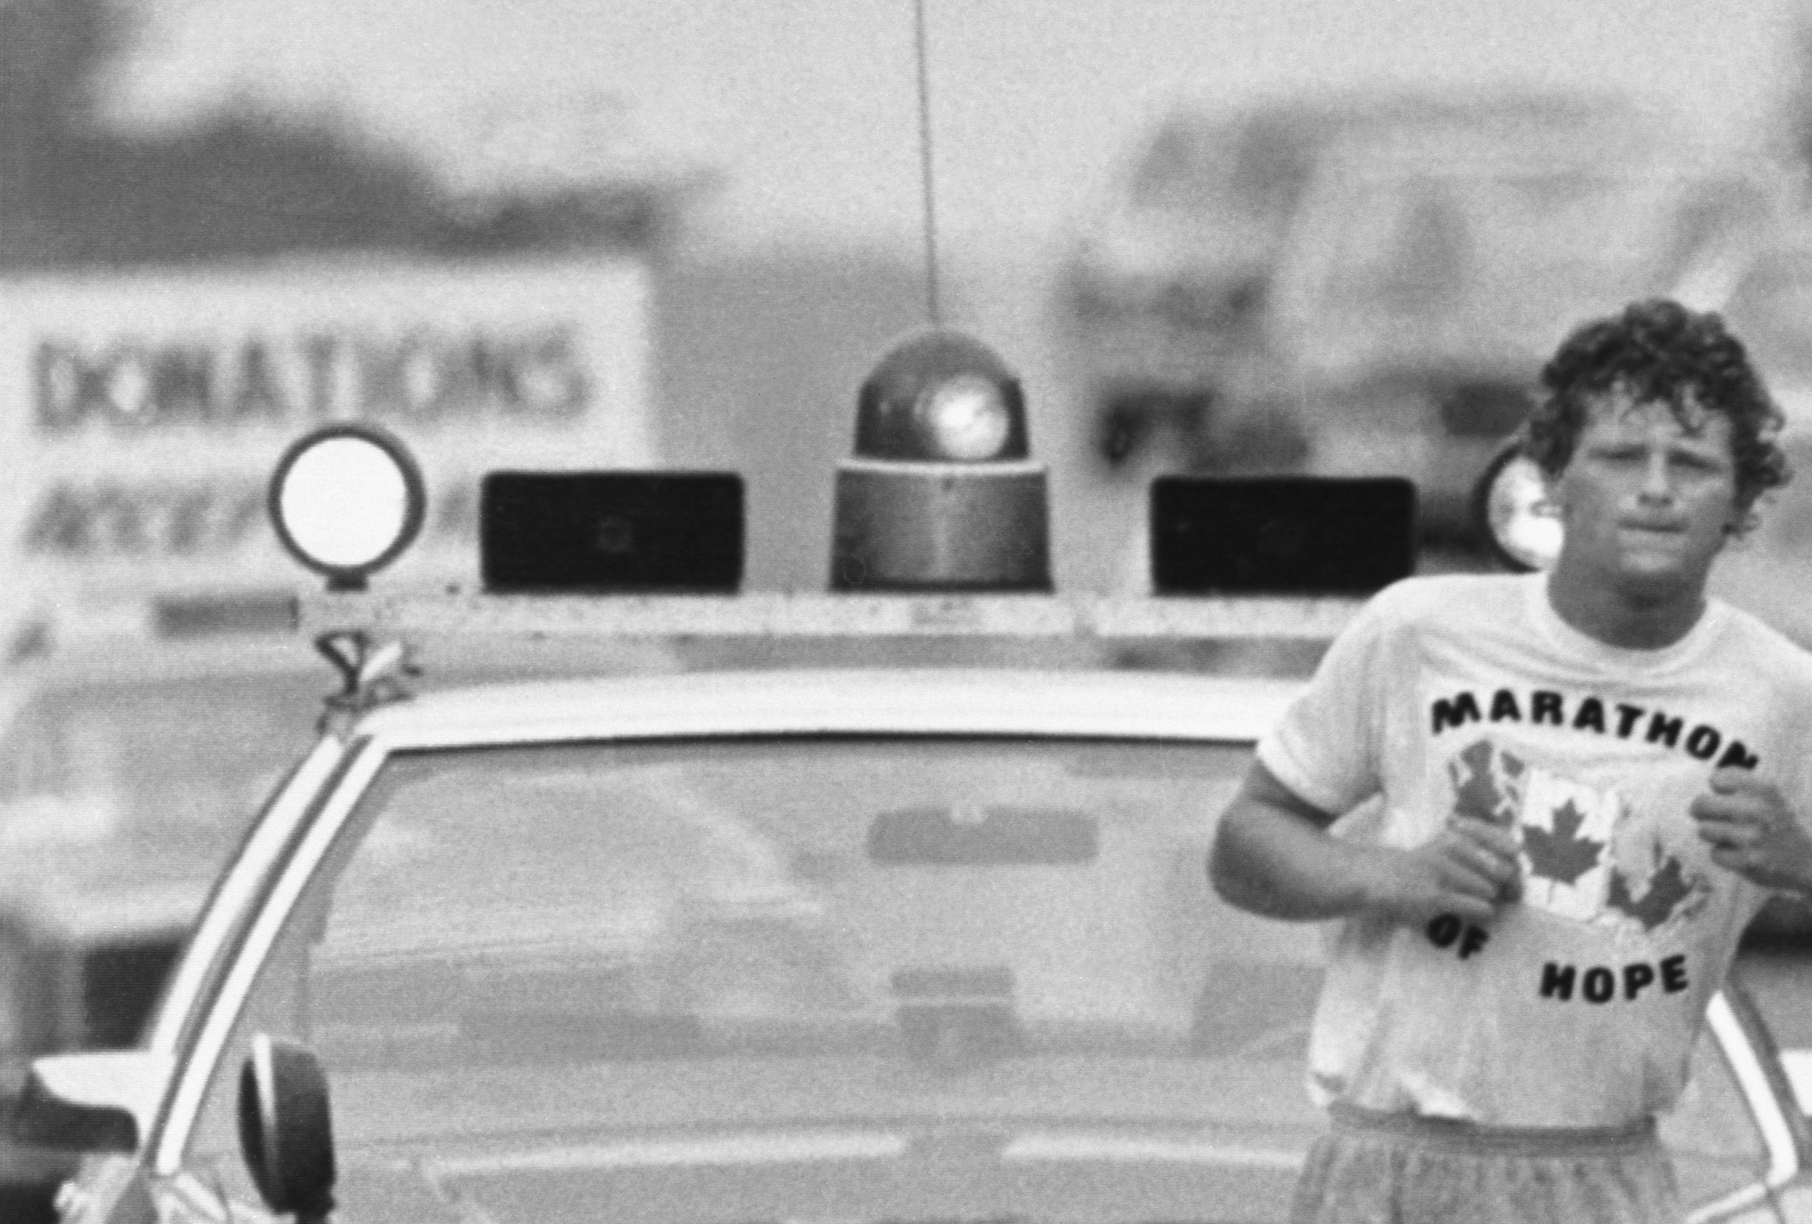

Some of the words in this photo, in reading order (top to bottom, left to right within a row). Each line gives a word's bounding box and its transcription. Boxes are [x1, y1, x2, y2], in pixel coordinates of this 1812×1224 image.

[30, 328, 594, 426] DONATIONS
[1431, 688, 1761, 772] MARATHON
[1425, 912, 1490, 961] OF
[1538, 953, 1691, 1004] HOPE
